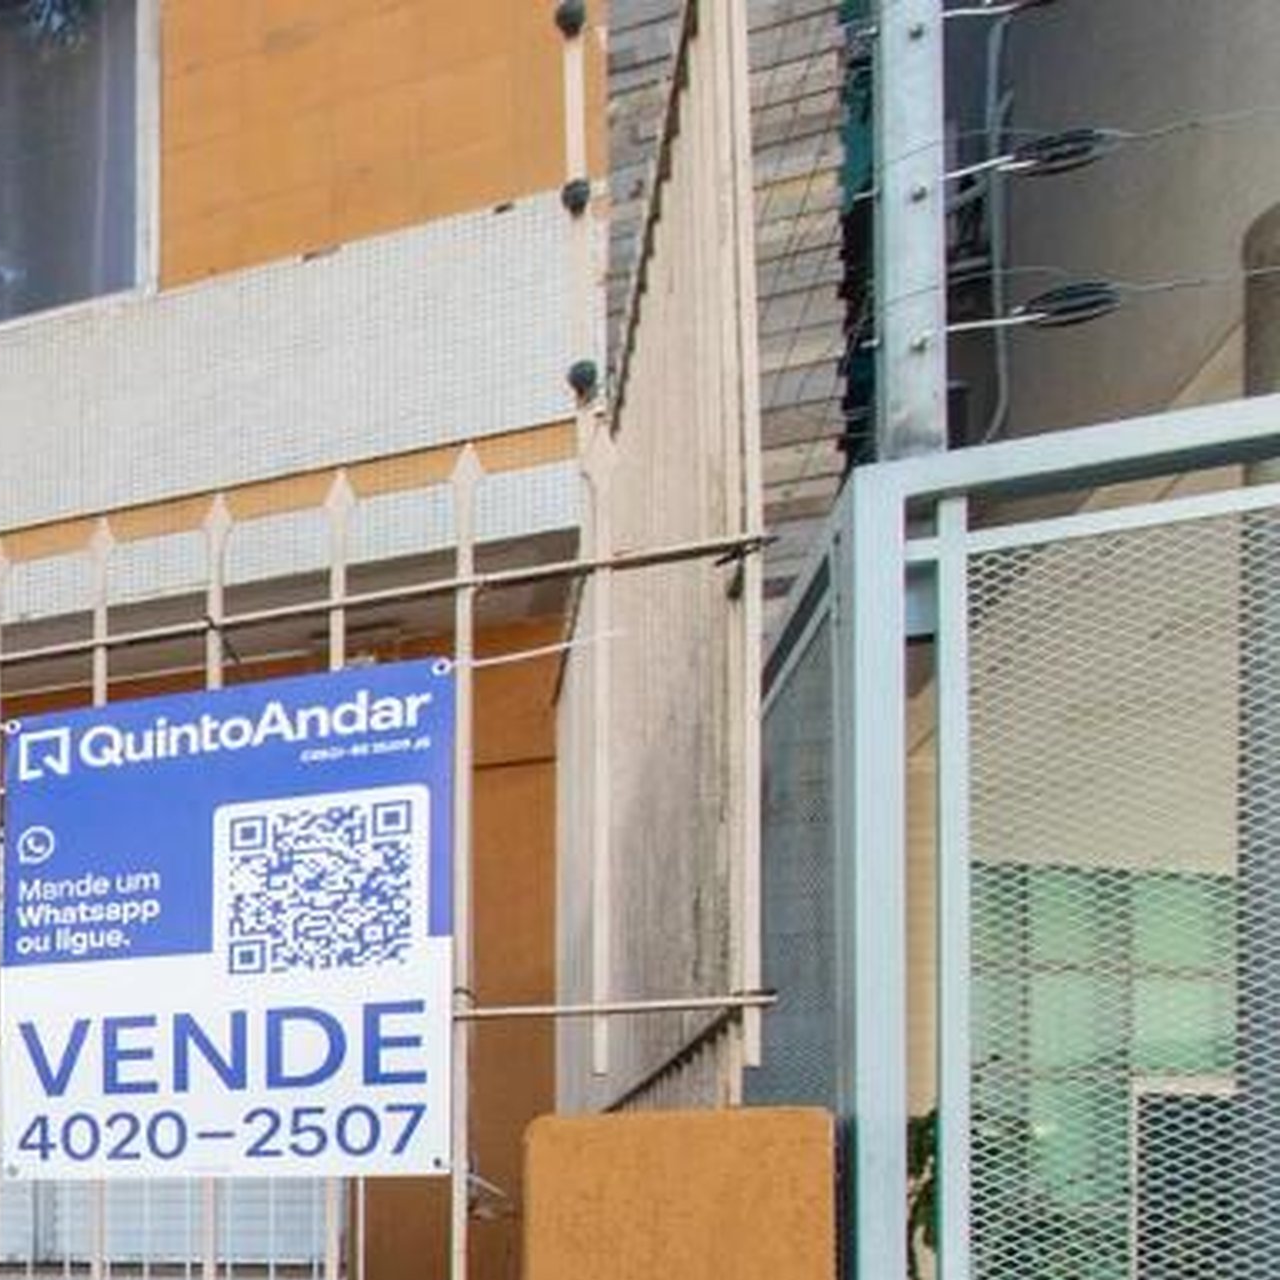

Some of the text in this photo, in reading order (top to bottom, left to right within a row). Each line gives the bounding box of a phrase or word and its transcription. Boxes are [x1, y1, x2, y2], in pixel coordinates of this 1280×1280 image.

[80, 690, 431, 768] QuintoAndar
[19, 874, 160, 902] Mande um
[17, 898, 160, 925] Whatsapp
[17, 924, 131, 954] ou ligue.
[18, 999, 427, 1098] VENDE
[18, 1104, 427, 1162] 4020-2507
